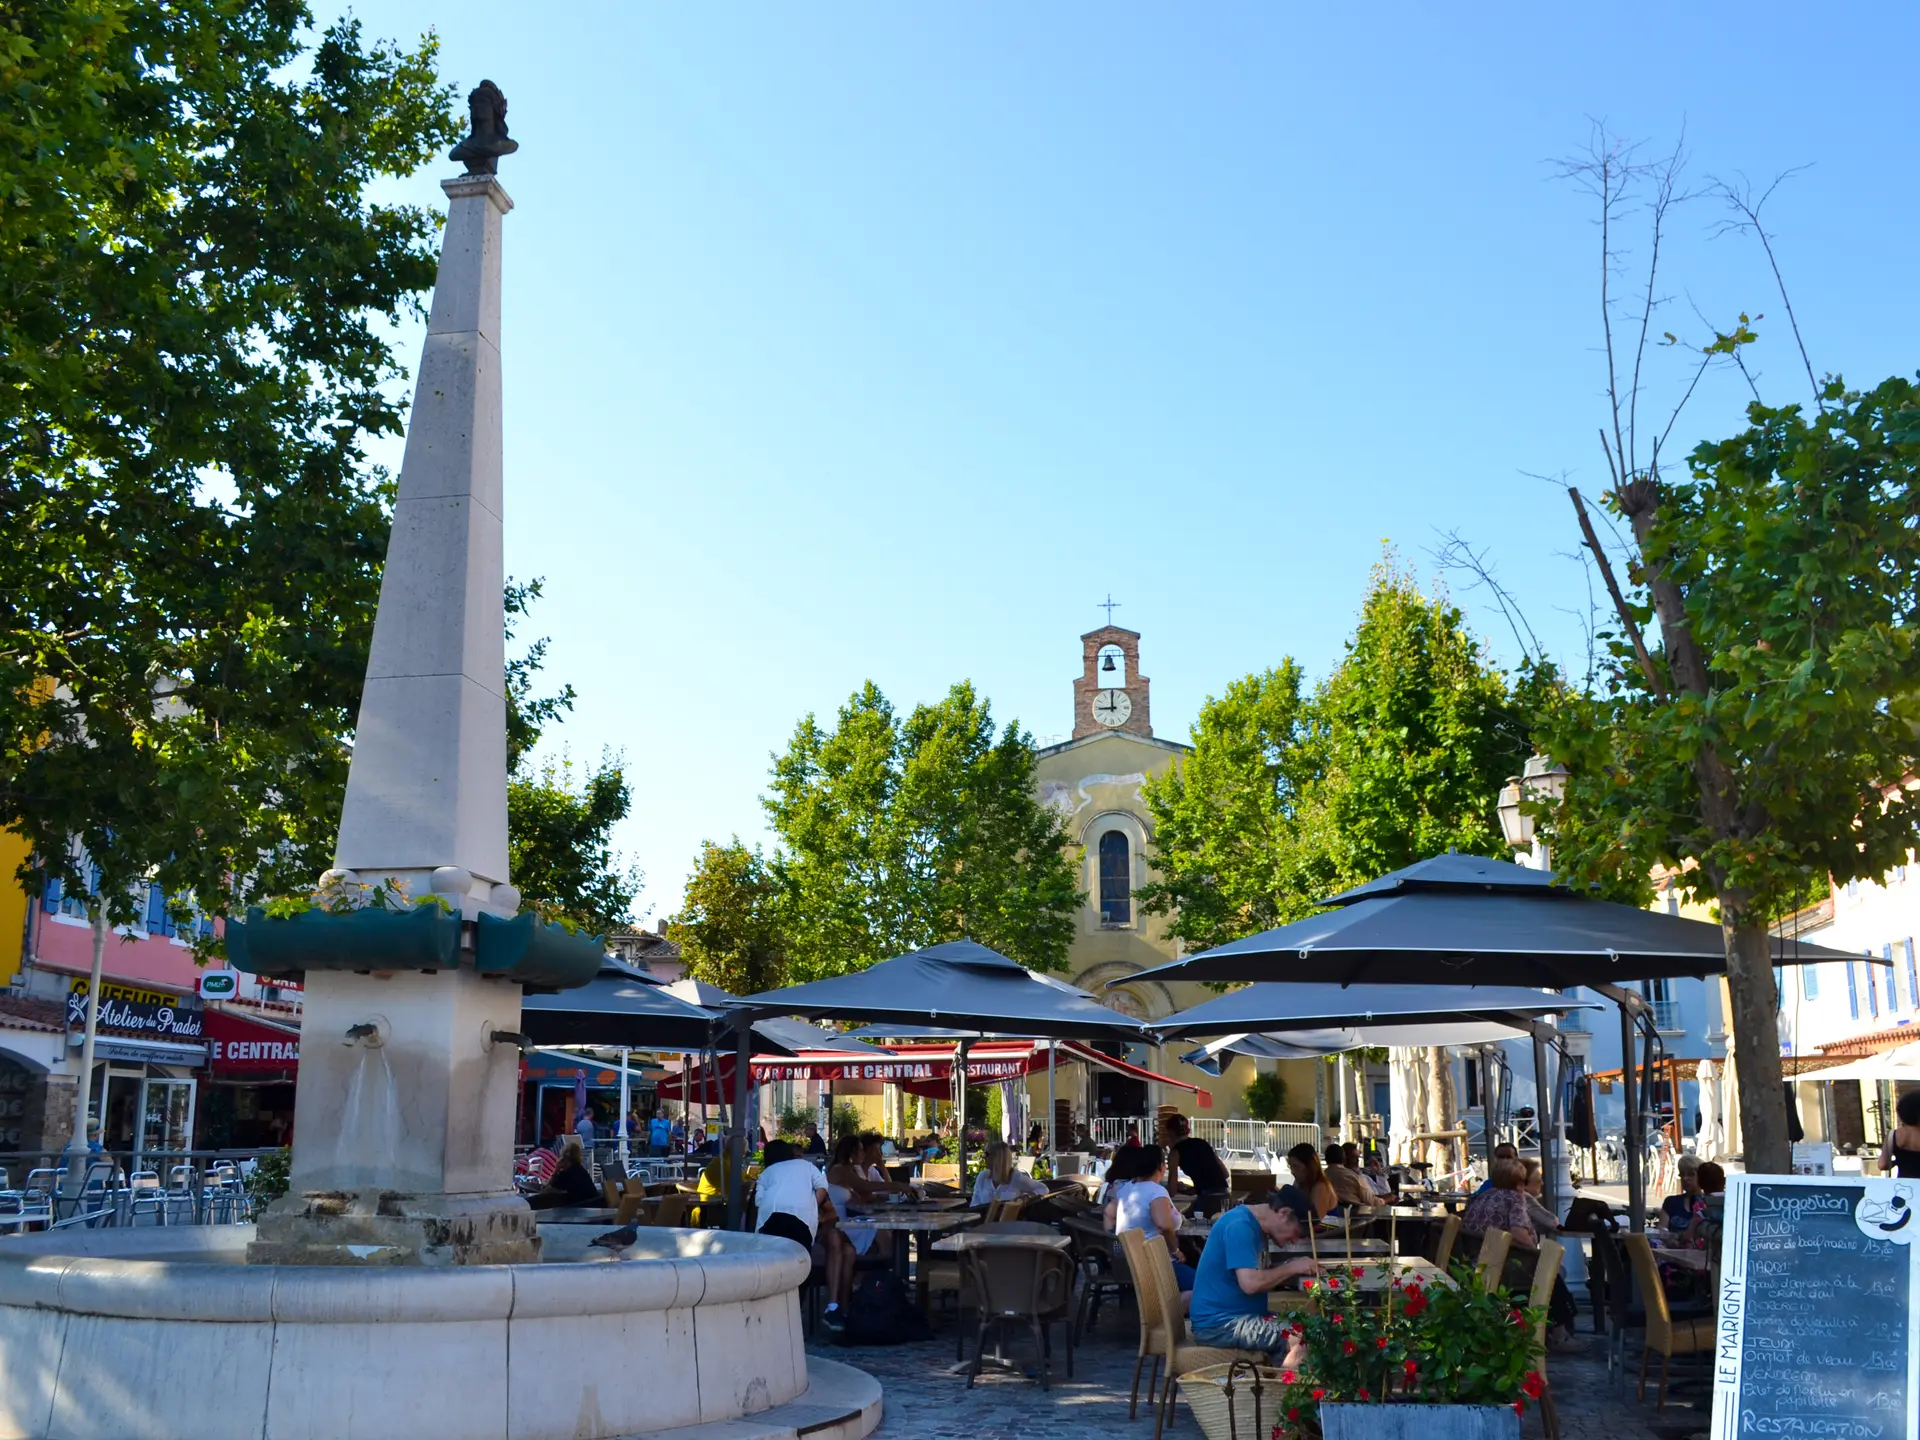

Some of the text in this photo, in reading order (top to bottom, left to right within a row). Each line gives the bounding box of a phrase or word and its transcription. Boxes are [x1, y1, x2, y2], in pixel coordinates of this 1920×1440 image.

[146, 1014, 157, 1027] du
[157, 1007, 202, 1036] Pradet
[756, 1062, 1022, 1080] BAR PMU LE CENTRAL ESTAURANT
[1754, 1186, 1849, 1221] Suggestion
[1783, 1238, 1797, 1249] de
[1719, 1278, 1741, 1384] LE MARIGNY
[1796, 1351, 1812, 1365] de
